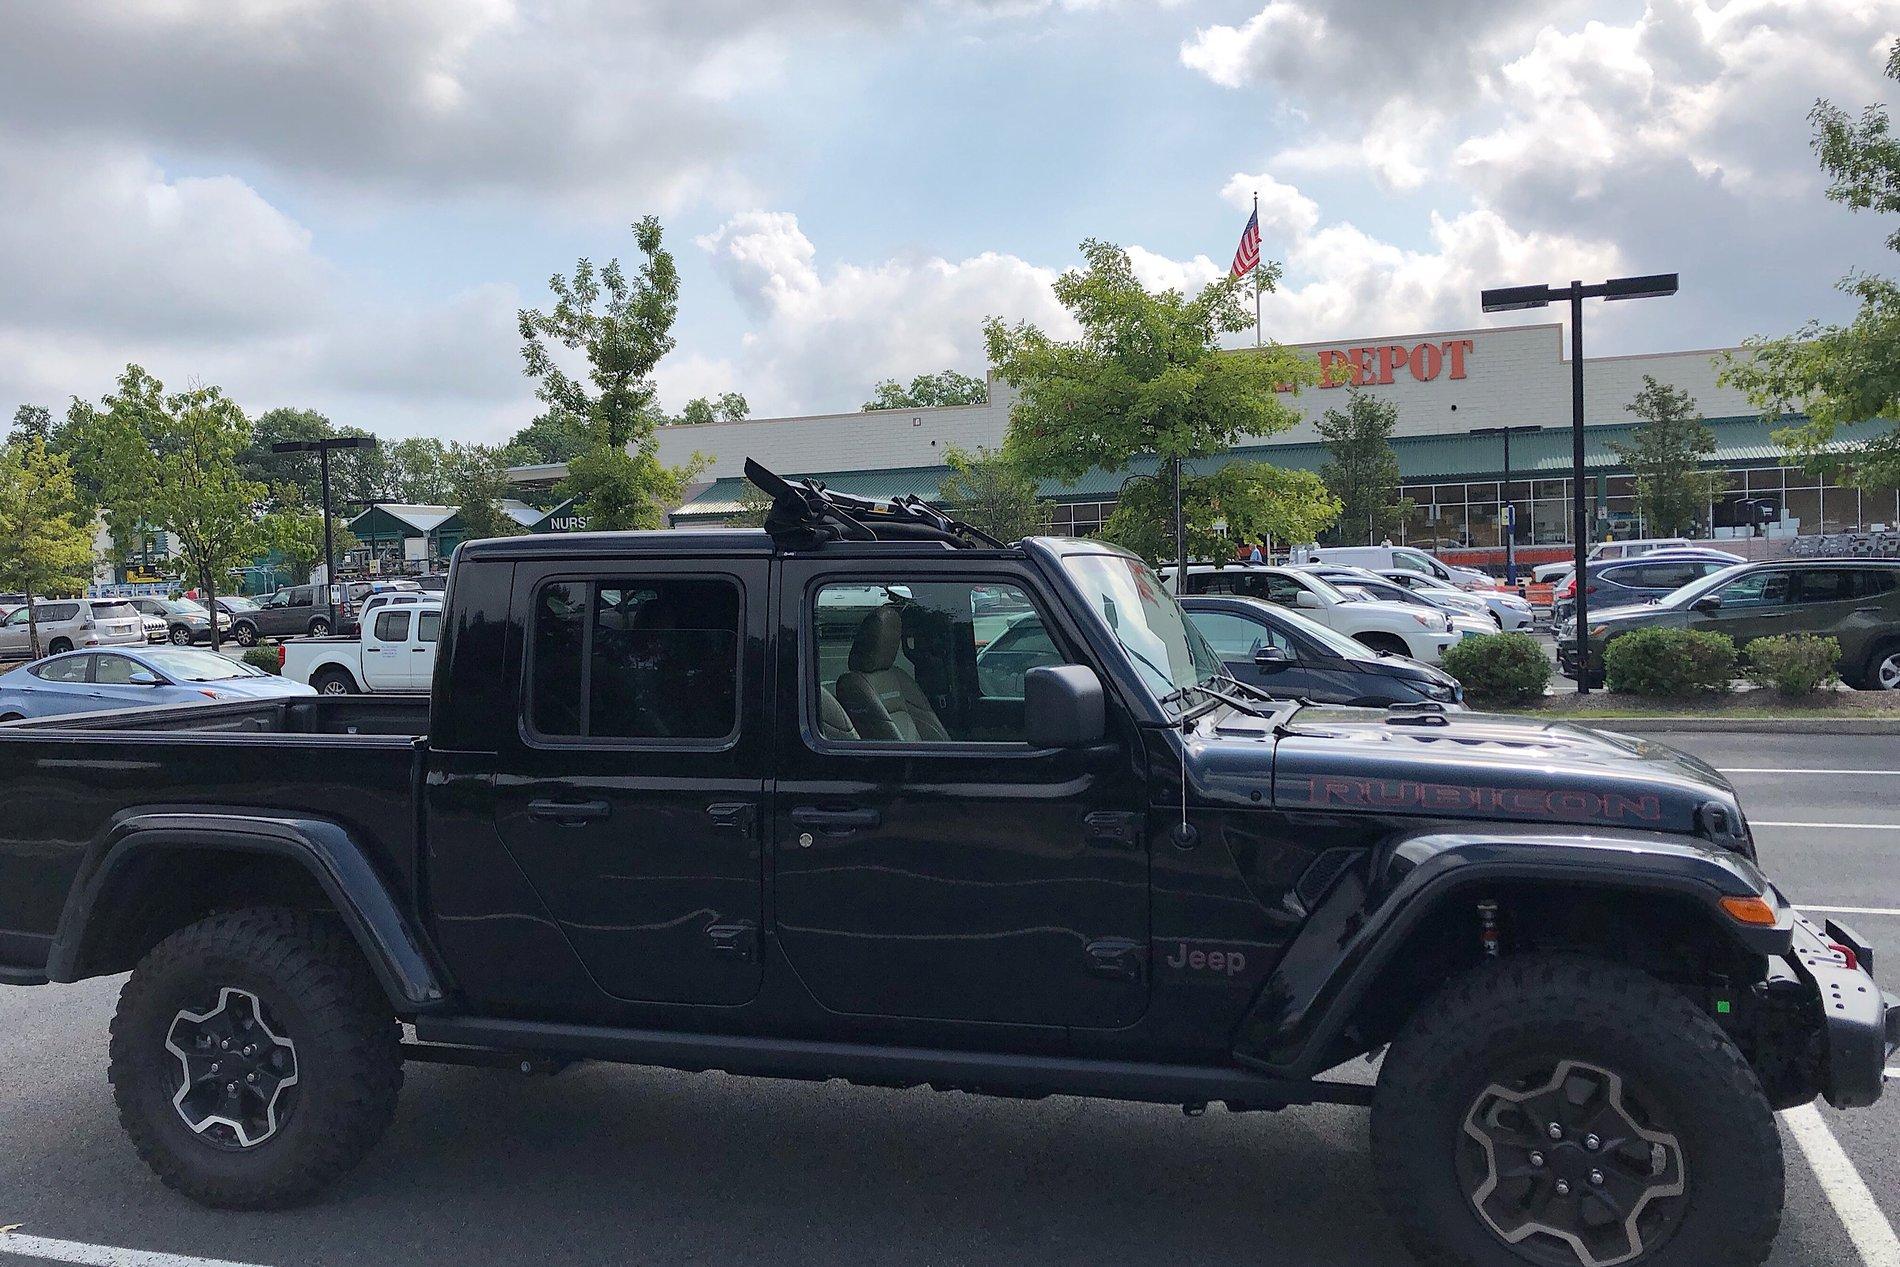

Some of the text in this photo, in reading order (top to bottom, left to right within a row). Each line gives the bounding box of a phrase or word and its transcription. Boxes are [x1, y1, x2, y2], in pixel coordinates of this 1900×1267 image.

[1317, 339, 1474, 389] DEPOT
[550, 516, 594, 530] NURS
[1308, 778, 1661, 821] RUBICON
[1167, 943, 1246, 976] Jeep
